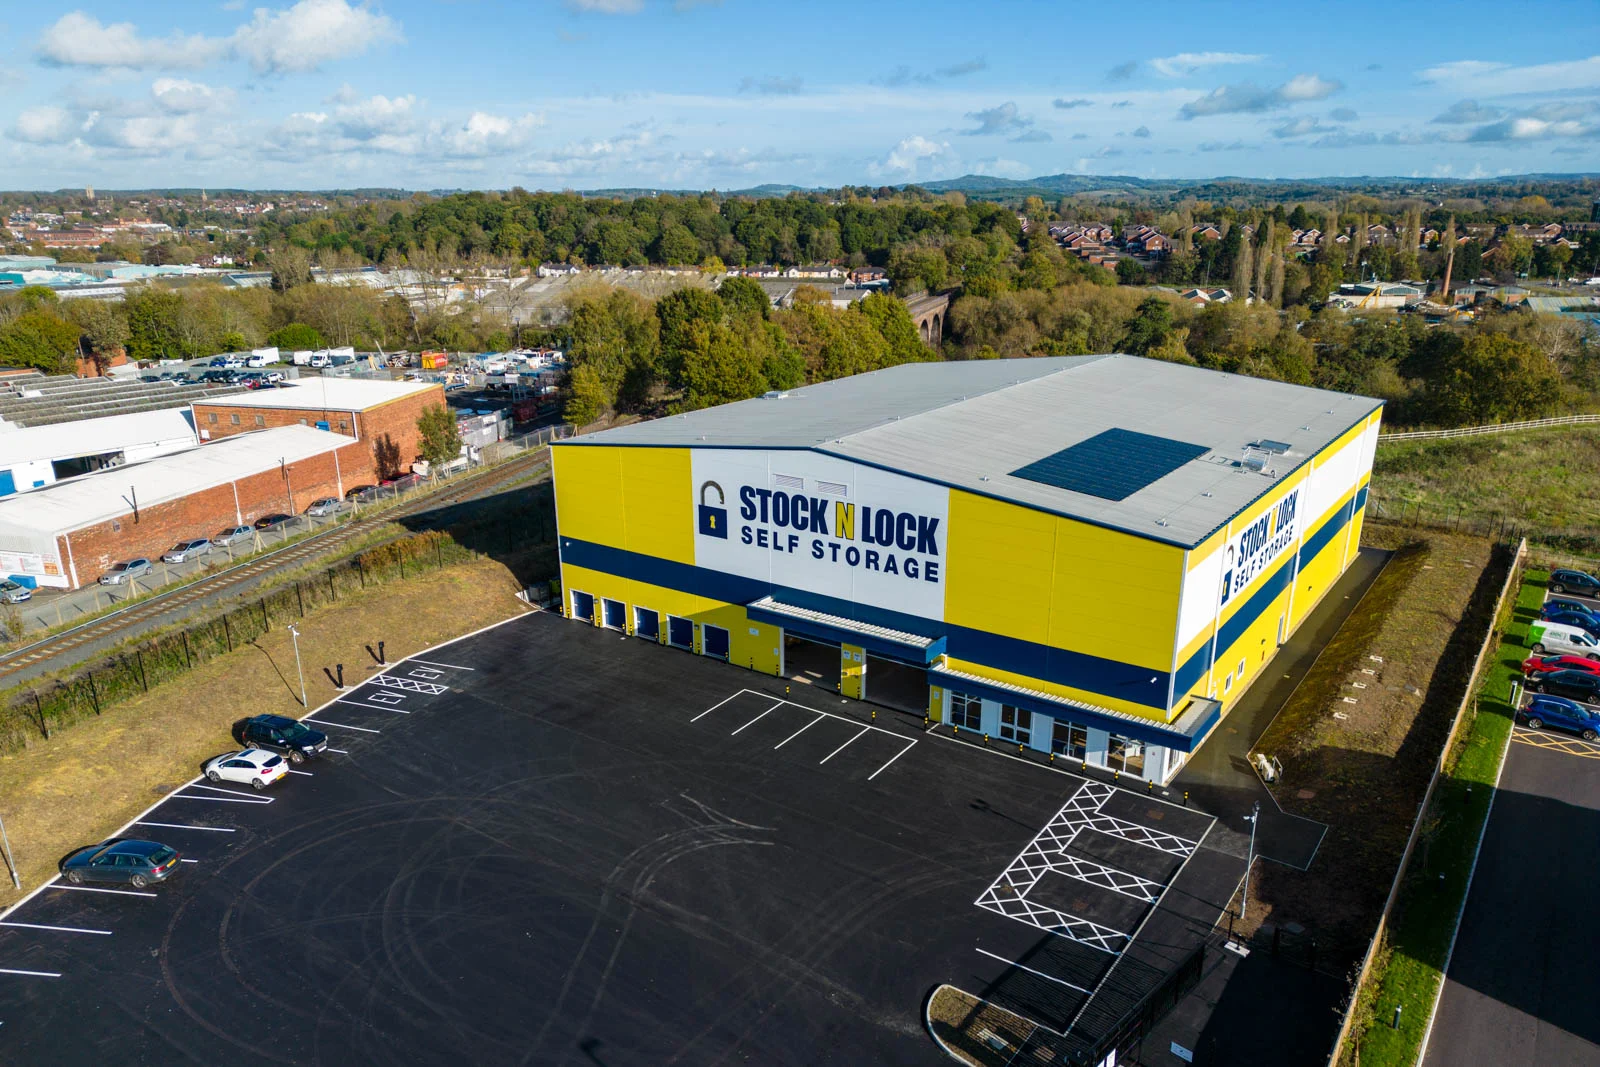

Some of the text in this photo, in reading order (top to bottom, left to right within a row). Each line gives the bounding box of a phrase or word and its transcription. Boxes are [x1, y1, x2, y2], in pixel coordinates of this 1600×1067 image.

[739, 485, 939, 556] STOCK N LOCK
[1238, 512, 1271, 568] STOCK
[1276, 489, 1299, 534] LOCK
[741, 525, 939, 583] SELF STORAGE
[1234, 525, 1294, 593] SELF STORAGE
[367, 690, 407, 704] EV
[408, 666, 445, 680] EV
